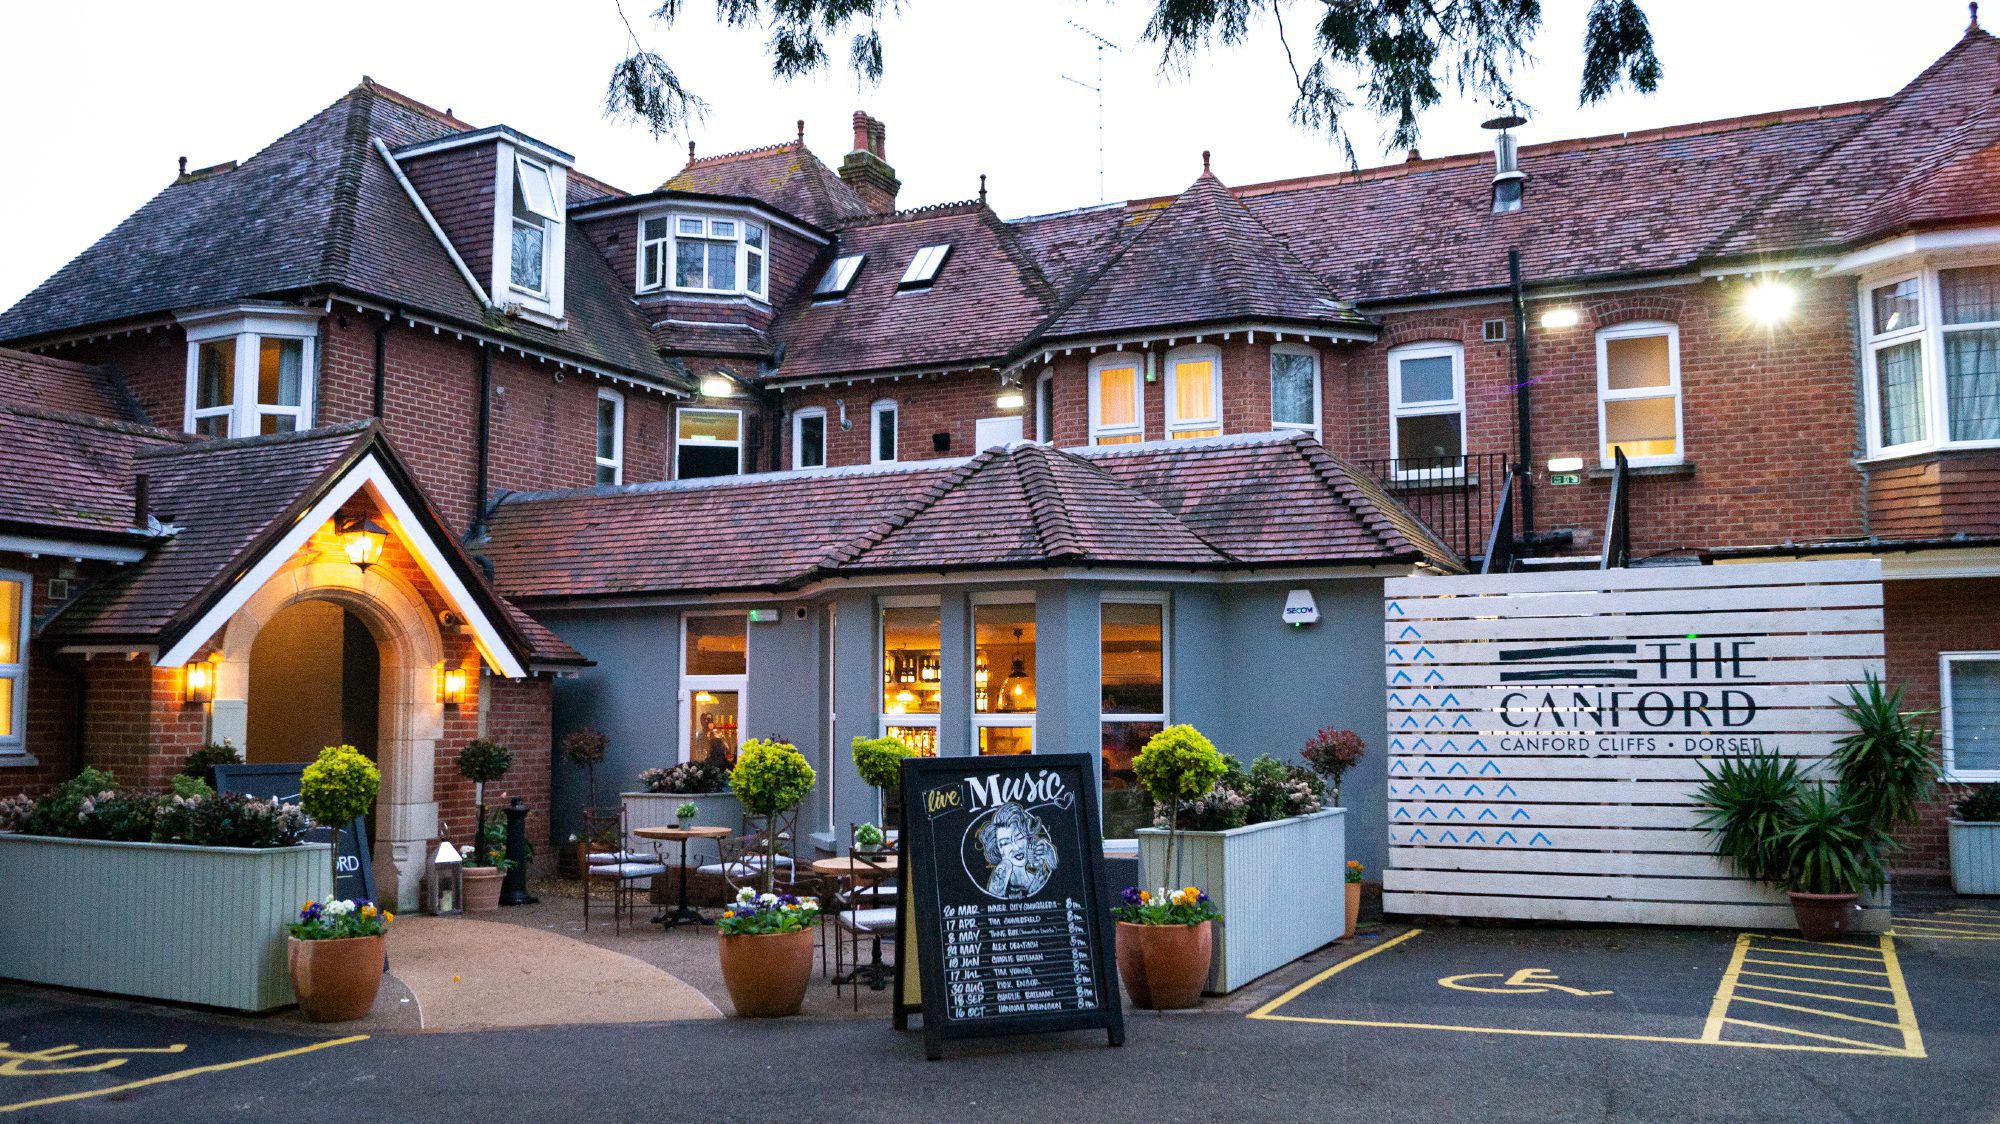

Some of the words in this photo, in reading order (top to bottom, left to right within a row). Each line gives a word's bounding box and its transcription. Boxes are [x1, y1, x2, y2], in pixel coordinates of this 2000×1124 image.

[1645, 641, 1756, 679] THE
[1500, 690, 1756, 728] CANFORD
[1500, 738, 1590, 751] CANFORD
[1598, 738, 1656, 751] CLIFFS
[1685, 737, 1760, 751] DORSET
[928, 790, 960, 812] live
[964, 770, 1065, 813] Music
[958, 905, 980, 916] MAR
[946, 920, 956, 930] 17
[959, 918, 978, 930] APR
[948, 933, 956, 944] 8
[959, 930, 980, 942] MAY
[960, 942, 982, 955] MAY
[992, 942, 1007, 952] ALEX
[960, 956, 980, 968] JUN
[951, 971, 960, 981] 17
[963, 969, 982, 980] JUL
[994, 968, 1008, 976] TIM
[951, 984, 963, 994] 30
[965, 982, 984, 994] AUG
[966, 994, 984, 1004] SEP
[956, 1008, 965, 1018] 16
[968, 1006, 986, 1017] OCT
